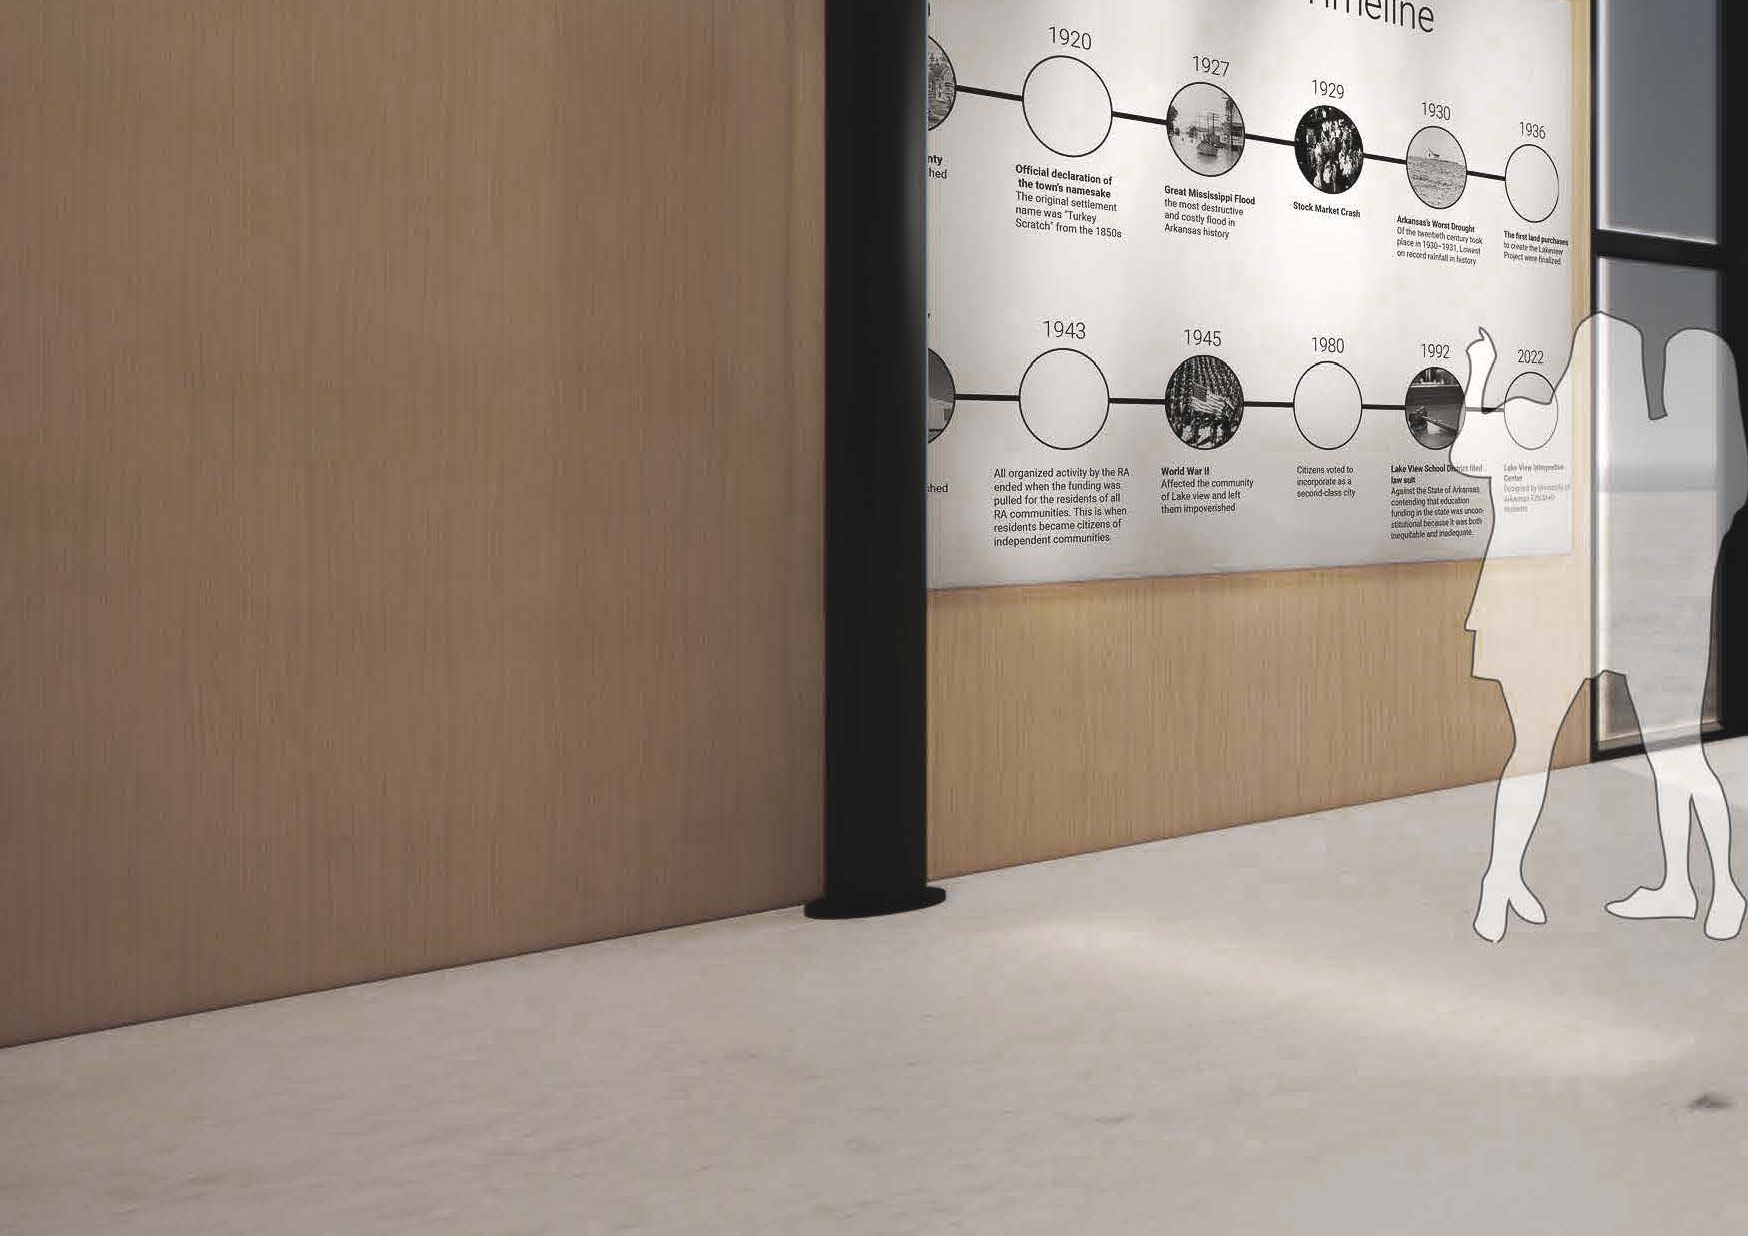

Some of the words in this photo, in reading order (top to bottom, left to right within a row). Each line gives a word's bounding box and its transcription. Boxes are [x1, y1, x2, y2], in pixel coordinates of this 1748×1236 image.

[1048, 26, 1092, 50] 1920
[1192, 55, 1230, 77] 1927
[1311, 79, 1345, 100] 1929
[1421, 102, 1451, 121] 1930
[1519, 121, 1546, 140] 1936
[1015, 164, 1049, 177] Official
[1051, 168, 1100, 183] declaration
[1102, 176, 1112, 185] of
[1018, 178, 1033, 188] the
[1065, 186, 1110, 198] namesake
[1164, 185, 1186, 196] Great
[1188, 188, 1232, 203] Mississippi
[1234, 194, 1255, 204] Flood
[1016, 190, 1033, 201] The
[1035, 194, 1068, 207] original
[1070, 199, 1116, 211] settlement
[1164, 198, 1177, 207] the
[1178, 201, 1199, 210] most
[1200, 202, 1243, 215] destructive
[1016, 207, 1041, 216] name
[1043, 210, 1062, 218] was
[1164, 211, 1179, 220] and
[1181, 212, 1204, 224] costly
[1206, 214, 1226, 225] flood
[1227, 217, 1235, 226] in
[1056, 221, 1077, 233] from
[1079, 224, 1093, 234] the
[1096, 226, 1121, 237] 1850s
[1164, 222, 1201, 235] Arkansas
[1202, 227, 1229, 240] history
[1043, 320, 1086, 340] 1943
[1183, 329, 1222, 347] 1945
[1311, 337, 1345, 353] 1980
[1421, 343, 1450, 359] 1992
[1517, 349, 1544, 364] 2022
[993, 468, 1007, 478] All
[1008, 468, 1053, 480] organized
[1055, 467, 1088, 479] activity
[1087, 467, 1101, 479] by
[1101, 467, 1116, 476] the
[1117, 467, 1129, 476] RA
[1161, 466, 1184, 475] World
[1186, 466, 1202, 475] War
[1204, 466, 1209, 475] II
[993, 482, 1022, 492] ended
[1024, 481, 1049, 491] when
[1051, 481, 1066, 490] the
[1068, 480, 1101, 493] funding
[1103, 482, 1122, 490] was
[1160, 478, 1195, 488] Affected
[1197, 478, 1210, 488] the
[1210, 478, 1254, 490] community
[993, 495, 1022, 507] pulled
[1024, 494, 1038, 504] for
[1039, 494, 1054, 504] the
[1056, 493, 1097, 503] residents
[1097, 493, 1108, 502] of
[1110, 493, 1120, 503] all
[1160, 491, 1170, 501] of
[1171, 491, 1192, 500] Lake
[1191, 491, 1210, 500] view
[1211, 490, 1226, 499] and
[1227, 490, 1240, 499] left
[993, 509, 1007, 519] RA
[1009, 507, 1071, 518] communities.
[1073, 507, 1092, 517] This
[1094, 507, 1102, 516] is
[1104, 506, 1126, 516] when
[1160, 504, 1182, 513] them
[993, 521, 1036, 532] residents
[1038, 520, 1075, 531] became
[1076, 519, 1112, 530] citizens
[1111, 519, 1121, 528] of
[993, 534, 1051, 548] independent
